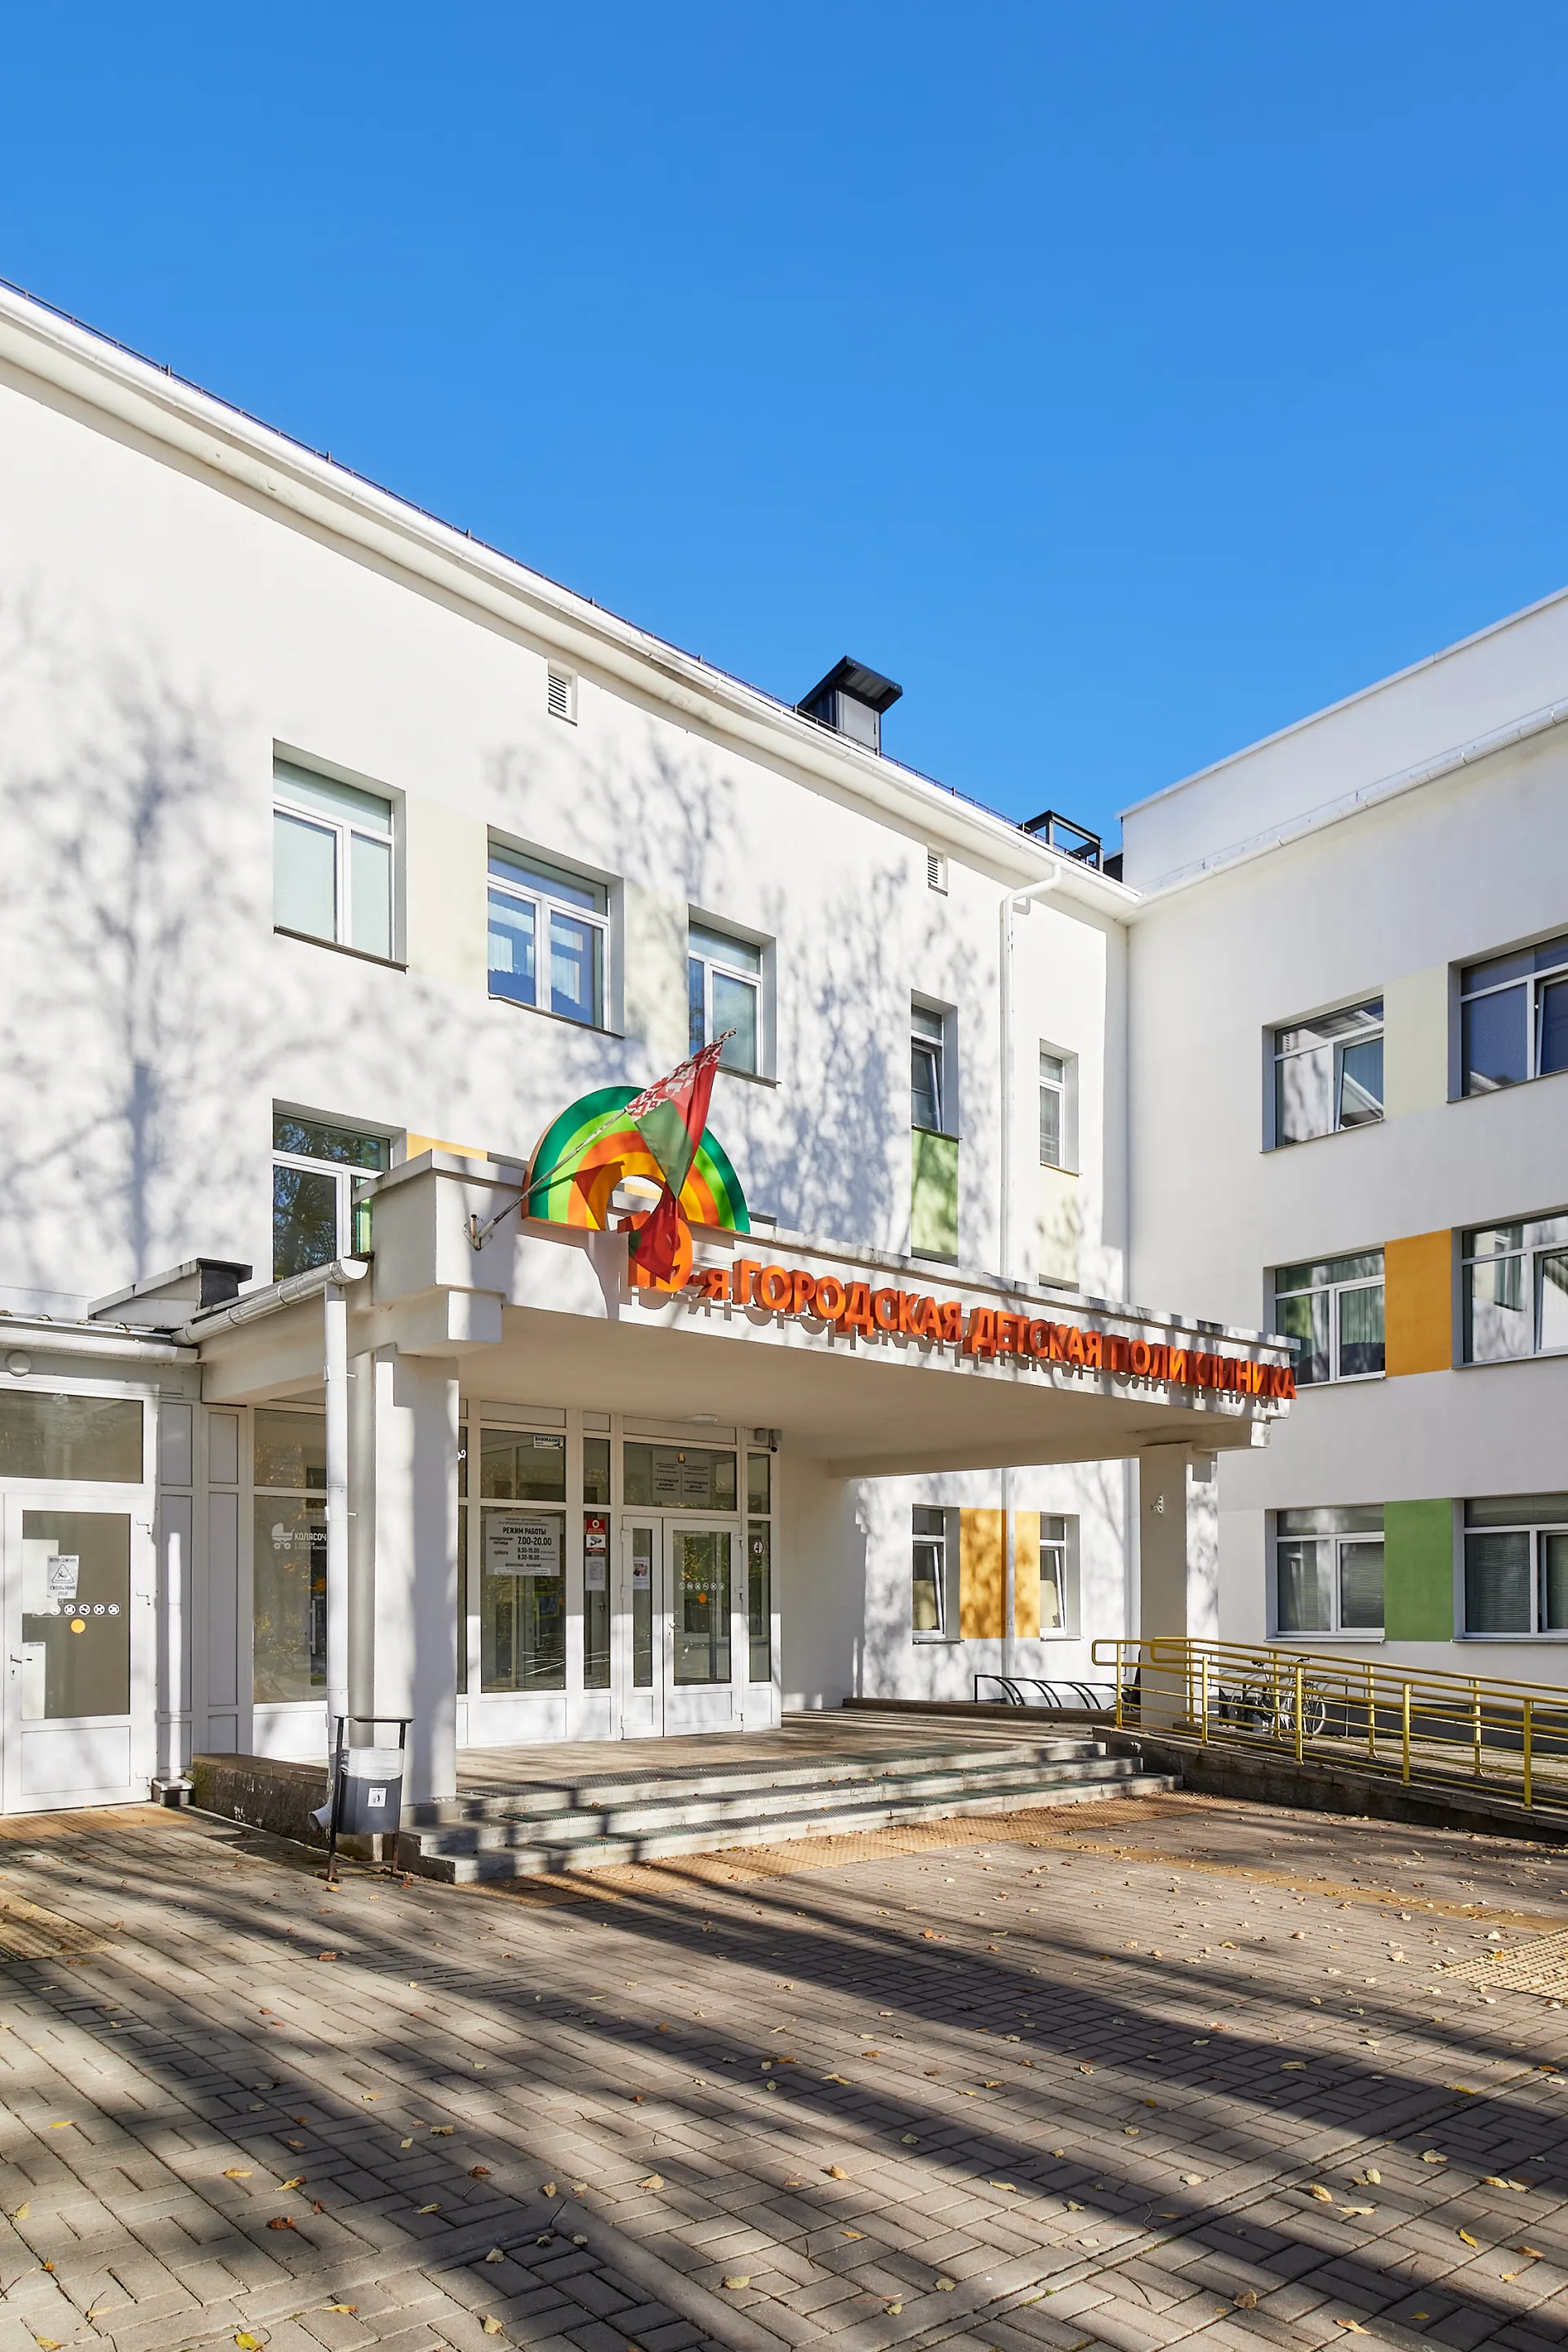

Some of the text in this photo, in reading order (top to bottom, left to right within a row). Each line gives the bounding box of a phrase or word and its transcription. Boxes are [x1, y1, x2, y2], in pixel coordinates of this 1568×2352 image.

[733, 1258, 961, 1342] ГОРОДСКАЯ
[964, 1307, 1102, 1369] ДЕТСКАЯ
[1103, 1334, 1297, 1400] ПОЛИКЛИНИКА
[517, 1536, 552, 1545] 7.00-20.00
